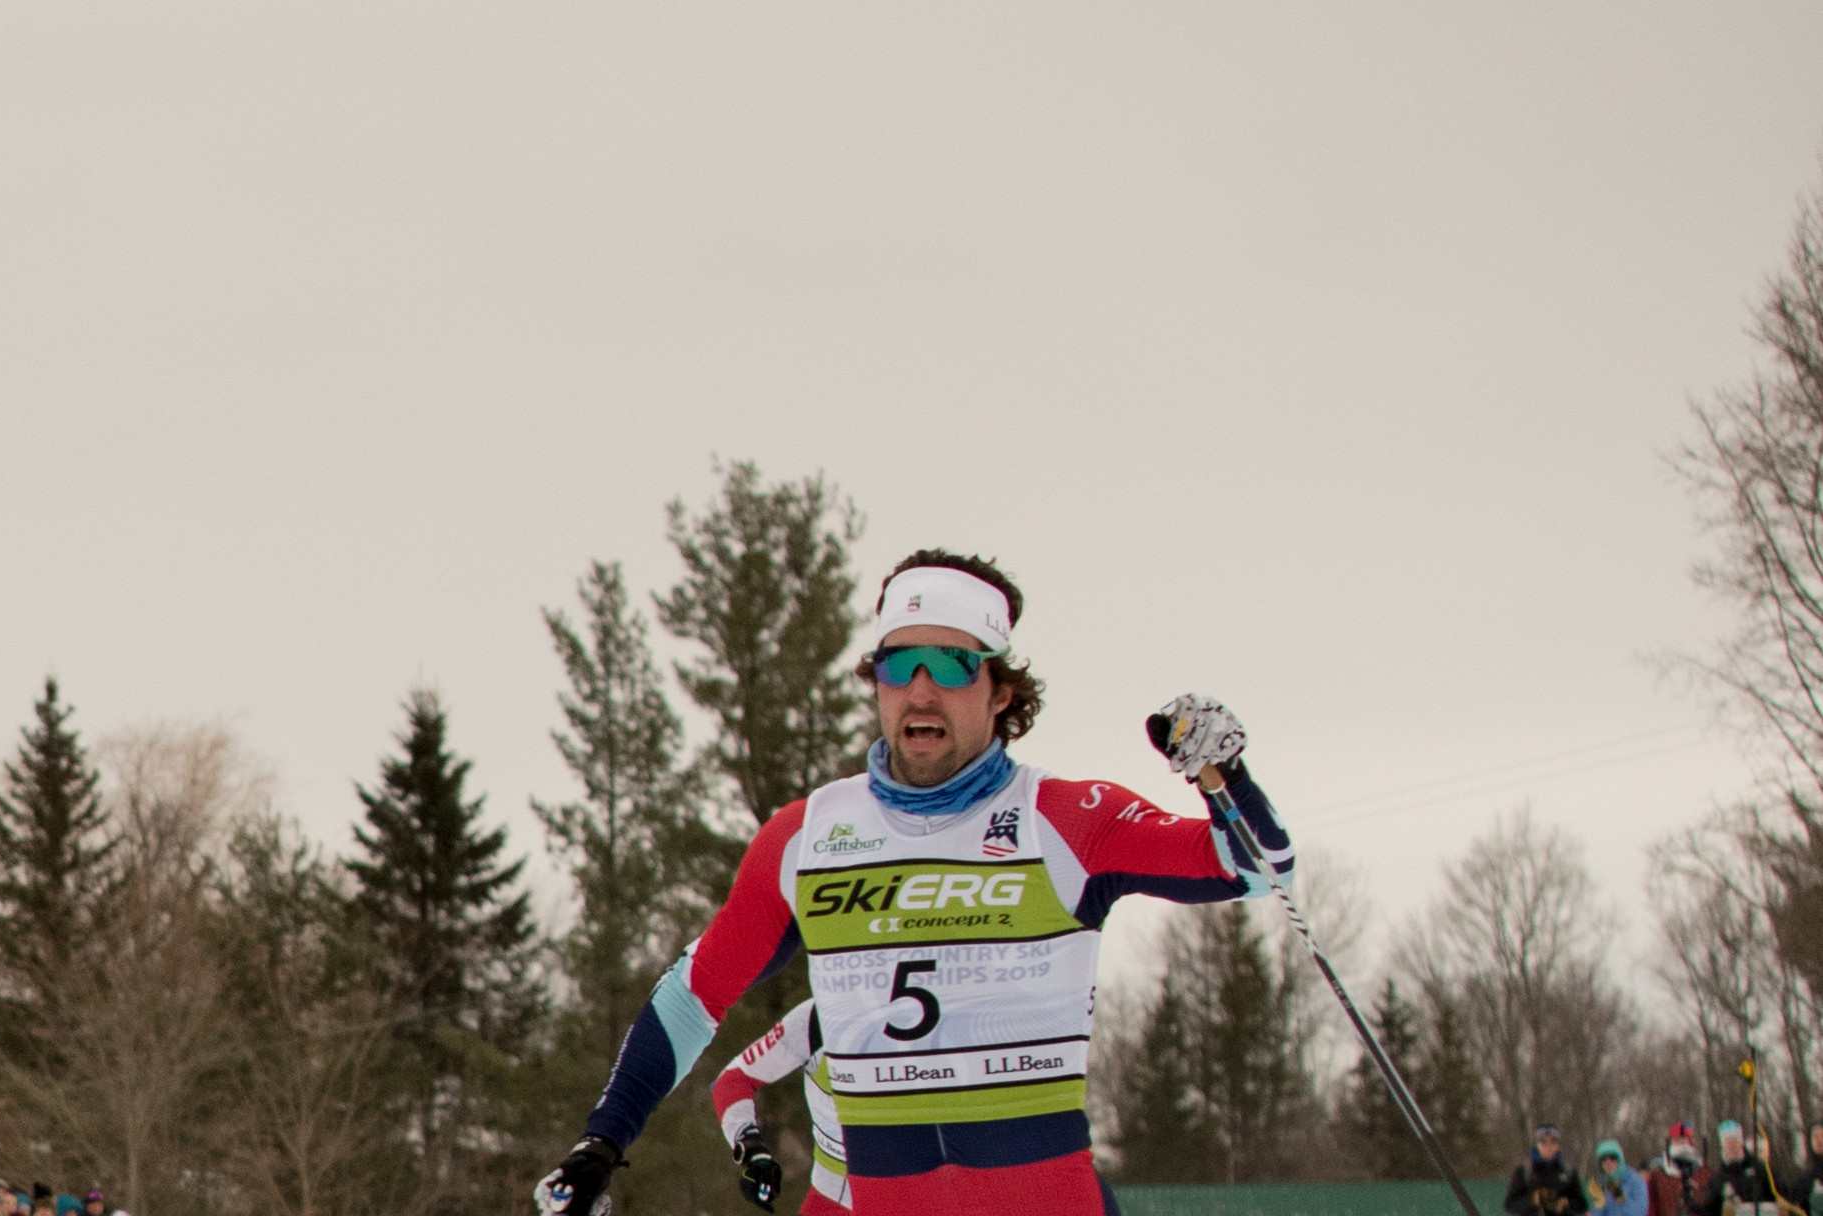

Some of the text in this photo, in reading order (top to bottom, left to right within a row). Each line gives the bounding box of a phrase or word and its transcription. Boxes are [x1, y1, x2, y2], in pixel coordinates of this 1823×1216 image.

[989, 807, 1021, 826] US
[813, 836, 888, 854] Craftsbury
[806, 872, 1027, 918] SkiERG
[903, 914, 991, 931] concept
[1016, 940, 1052, 960] SKI
[994, 961, 1052, 983] 2019
[882, 959, 942, 1042] 5
